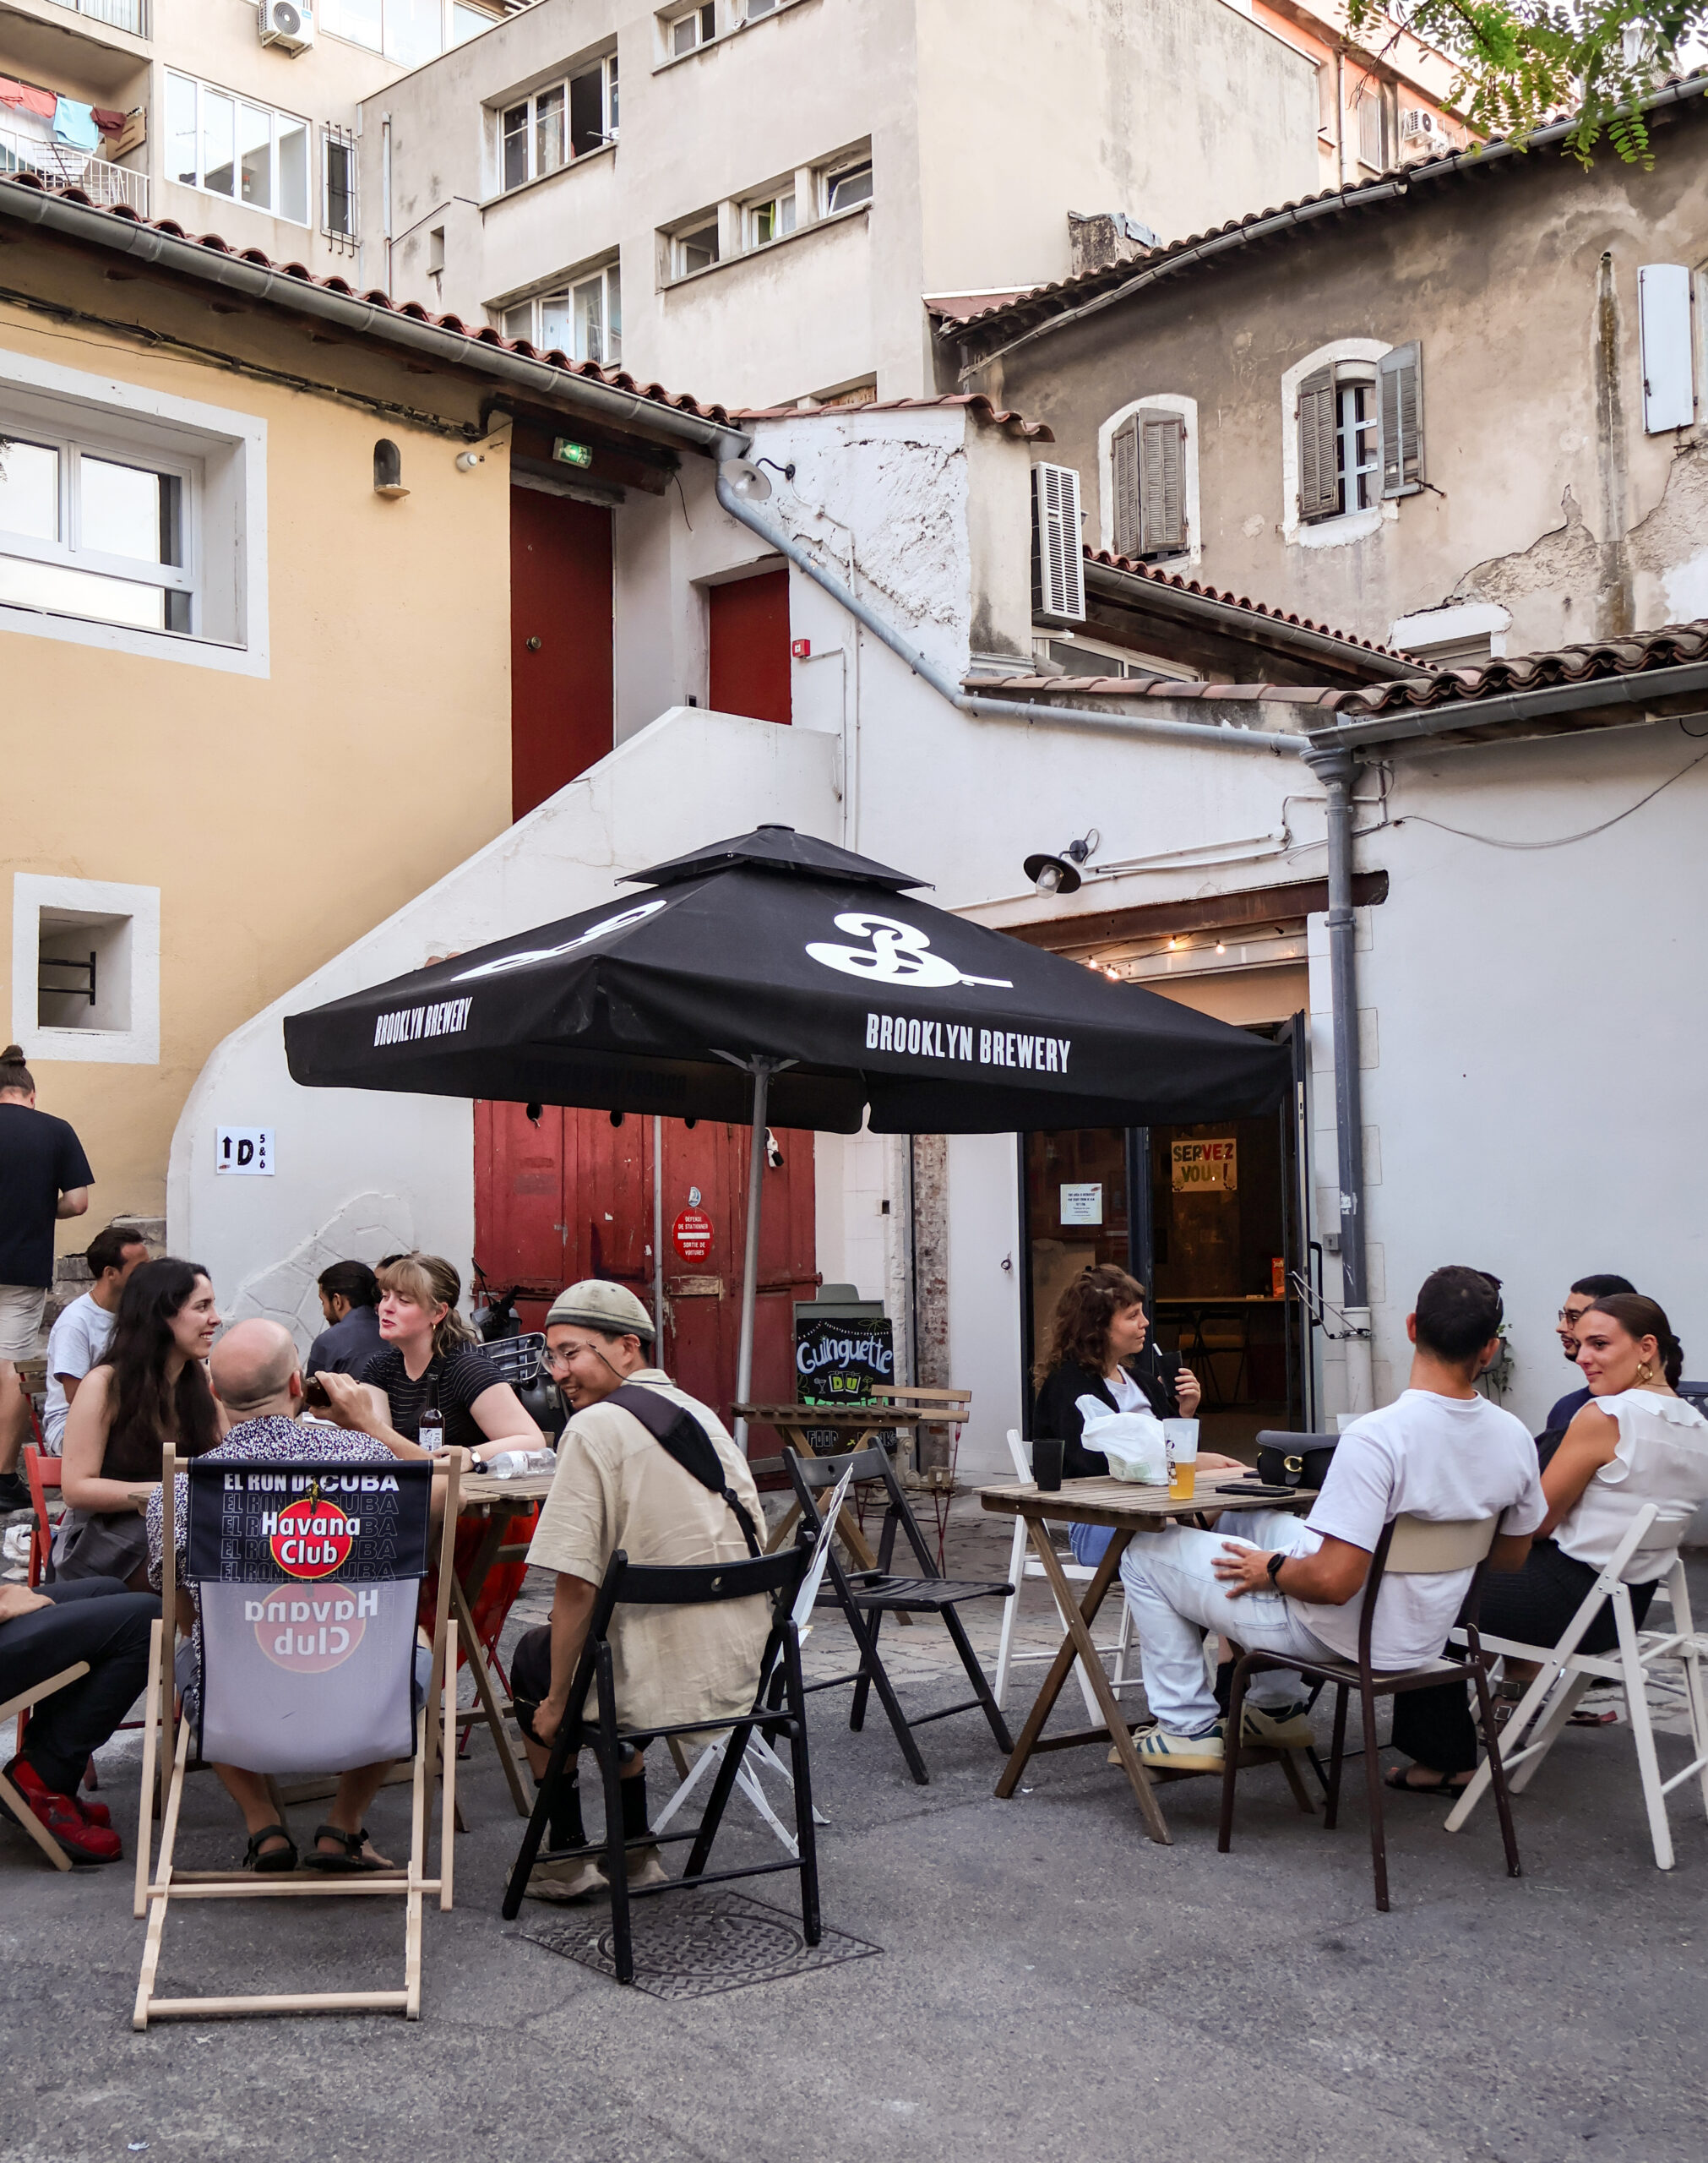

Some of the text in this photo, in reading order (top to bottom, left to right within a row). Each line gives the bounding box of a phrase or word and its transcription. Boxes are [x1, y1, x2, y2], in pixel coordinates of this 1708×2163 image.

[373, 996, 473, 1047] BROOKLYN BREWERY
[866, 1013, 1071, 1074] BROOKLYN BREWERY
[237, 1139, 254, 1166] D
[259, 1134, 265, 1169] 5 & 6
[1173, 1143, 1233, 1162] SERVEZ
[797, 1335, 893, 1374] Guinguette
[832, 1376, 857, 1391] DU
[224, 1474, 243, 1490] EL
[247, 1474, 287, 1492] RON
[319, 1474, 400, 1493] CUBA
[222, 1493, 243, 1514] EL
[221, 1515, 242, 1537] EL
[262, 1512, 361, 1536] Havana
[220, 1538, 242, 1560] EL
[280, 1539, 338, 1564] Club
[220, 1561, 241, 1583] EL
